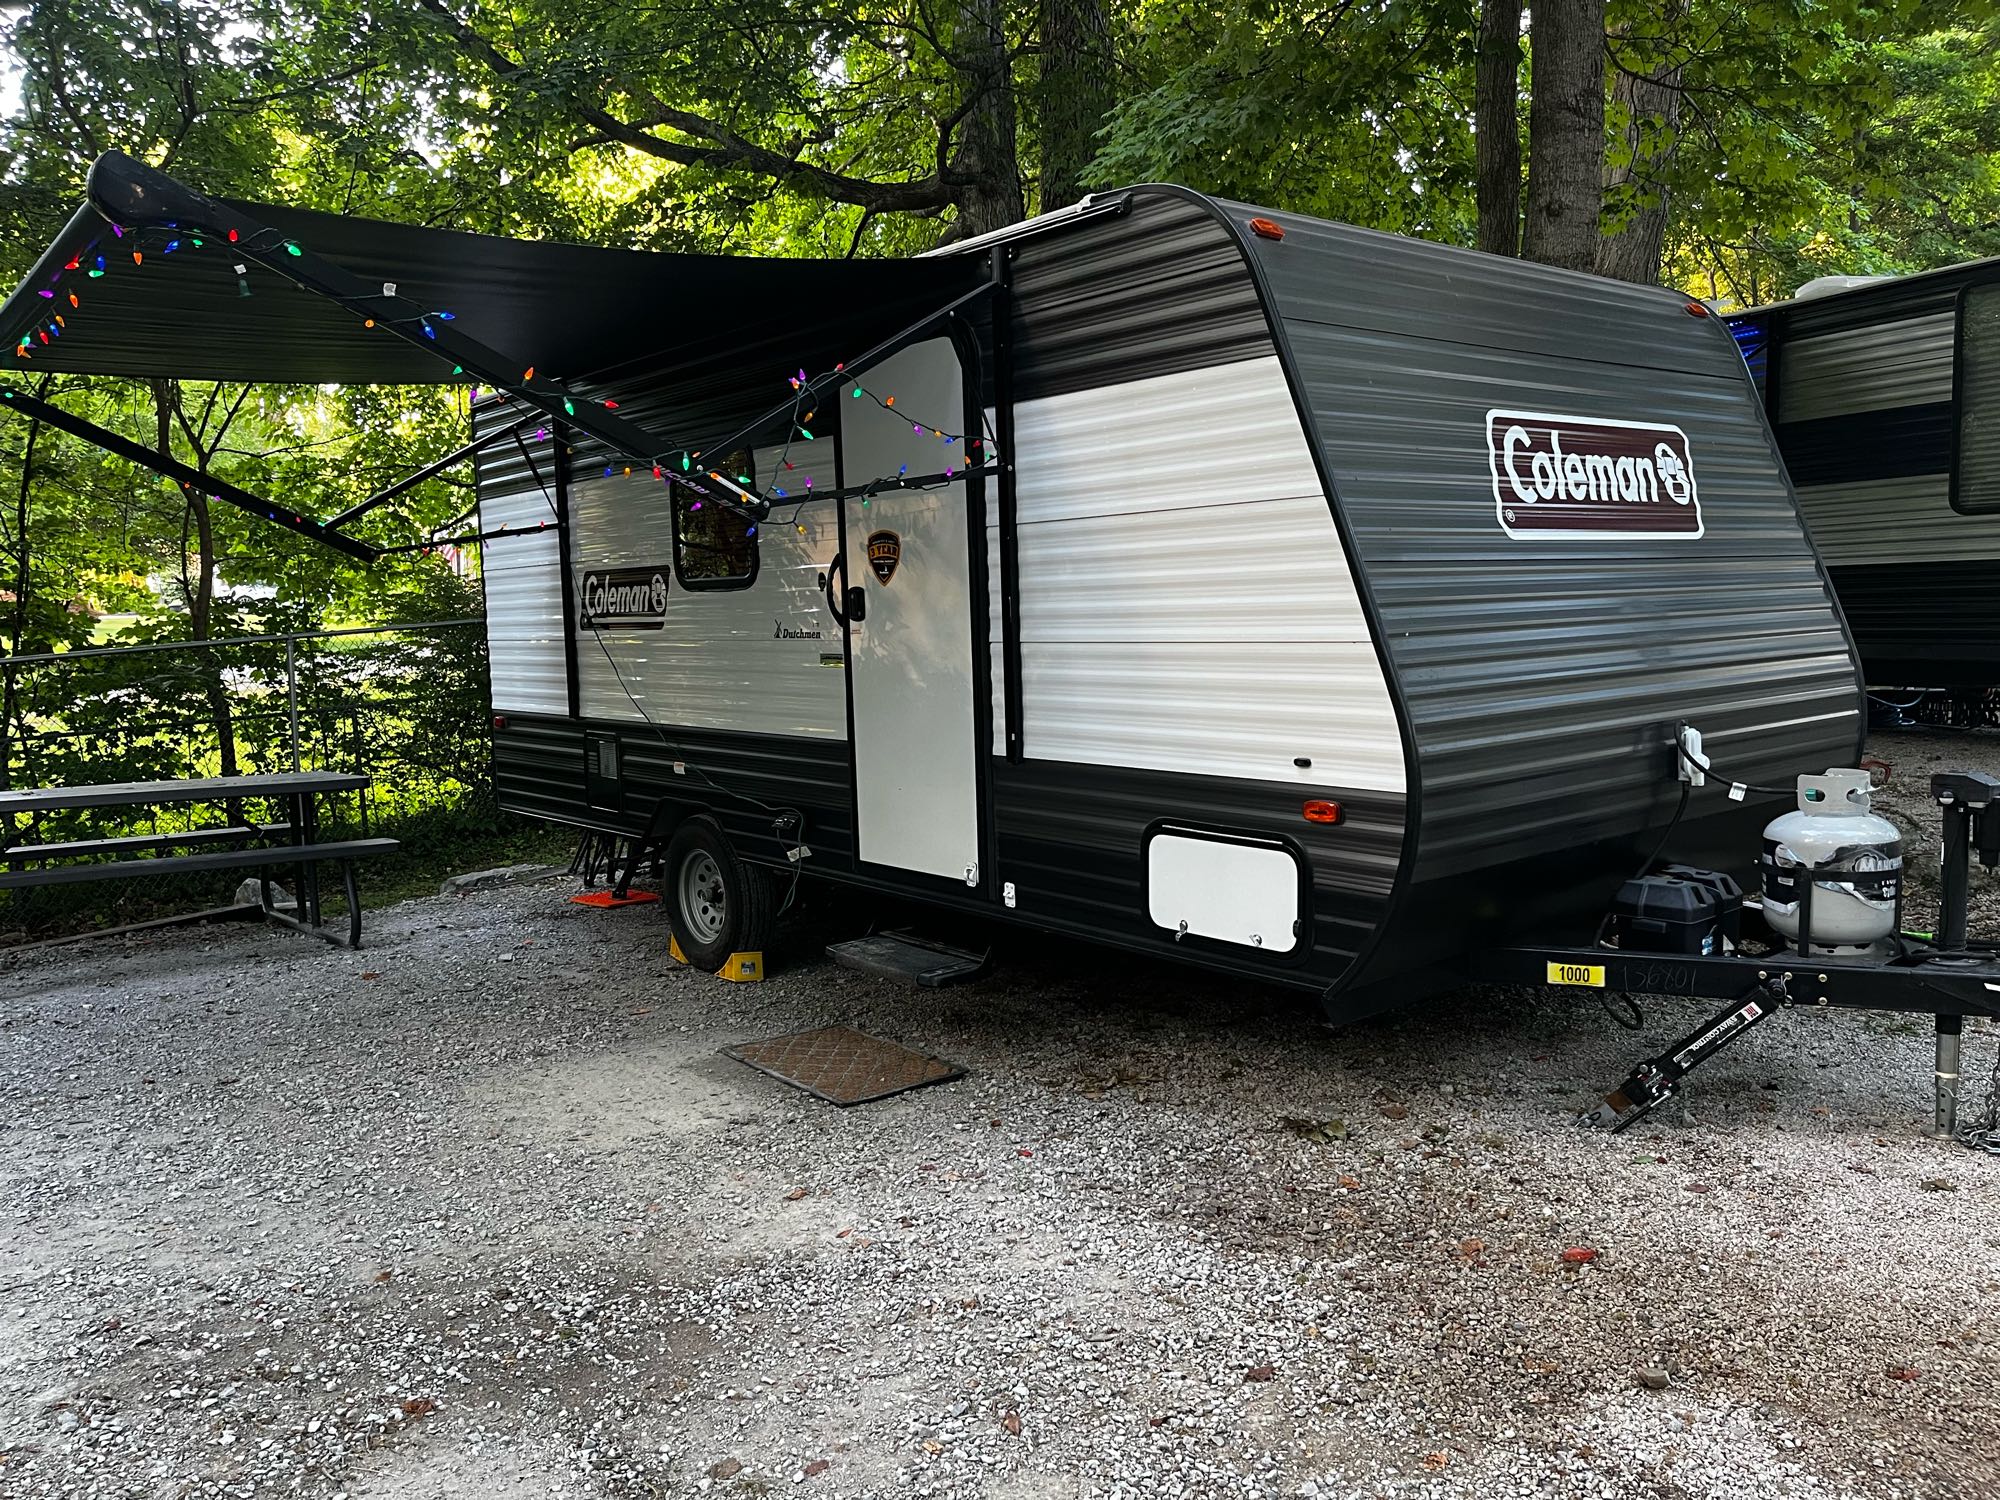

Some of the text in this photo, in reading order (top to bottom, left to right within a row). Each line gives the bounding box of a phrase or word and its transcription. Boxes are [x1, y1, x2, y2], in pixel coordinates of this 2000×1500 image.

[1503, 425, 1660, 504] Coleman
[869, 544, 897, 558] 3 YEAR
[585, 574, 651, 617] Coleman
[782, 628, 821, 639] Dutchmen
[1559, 966, 1590, 983] 1000
[1691, 1028, 1720, 1051] CONTROL
